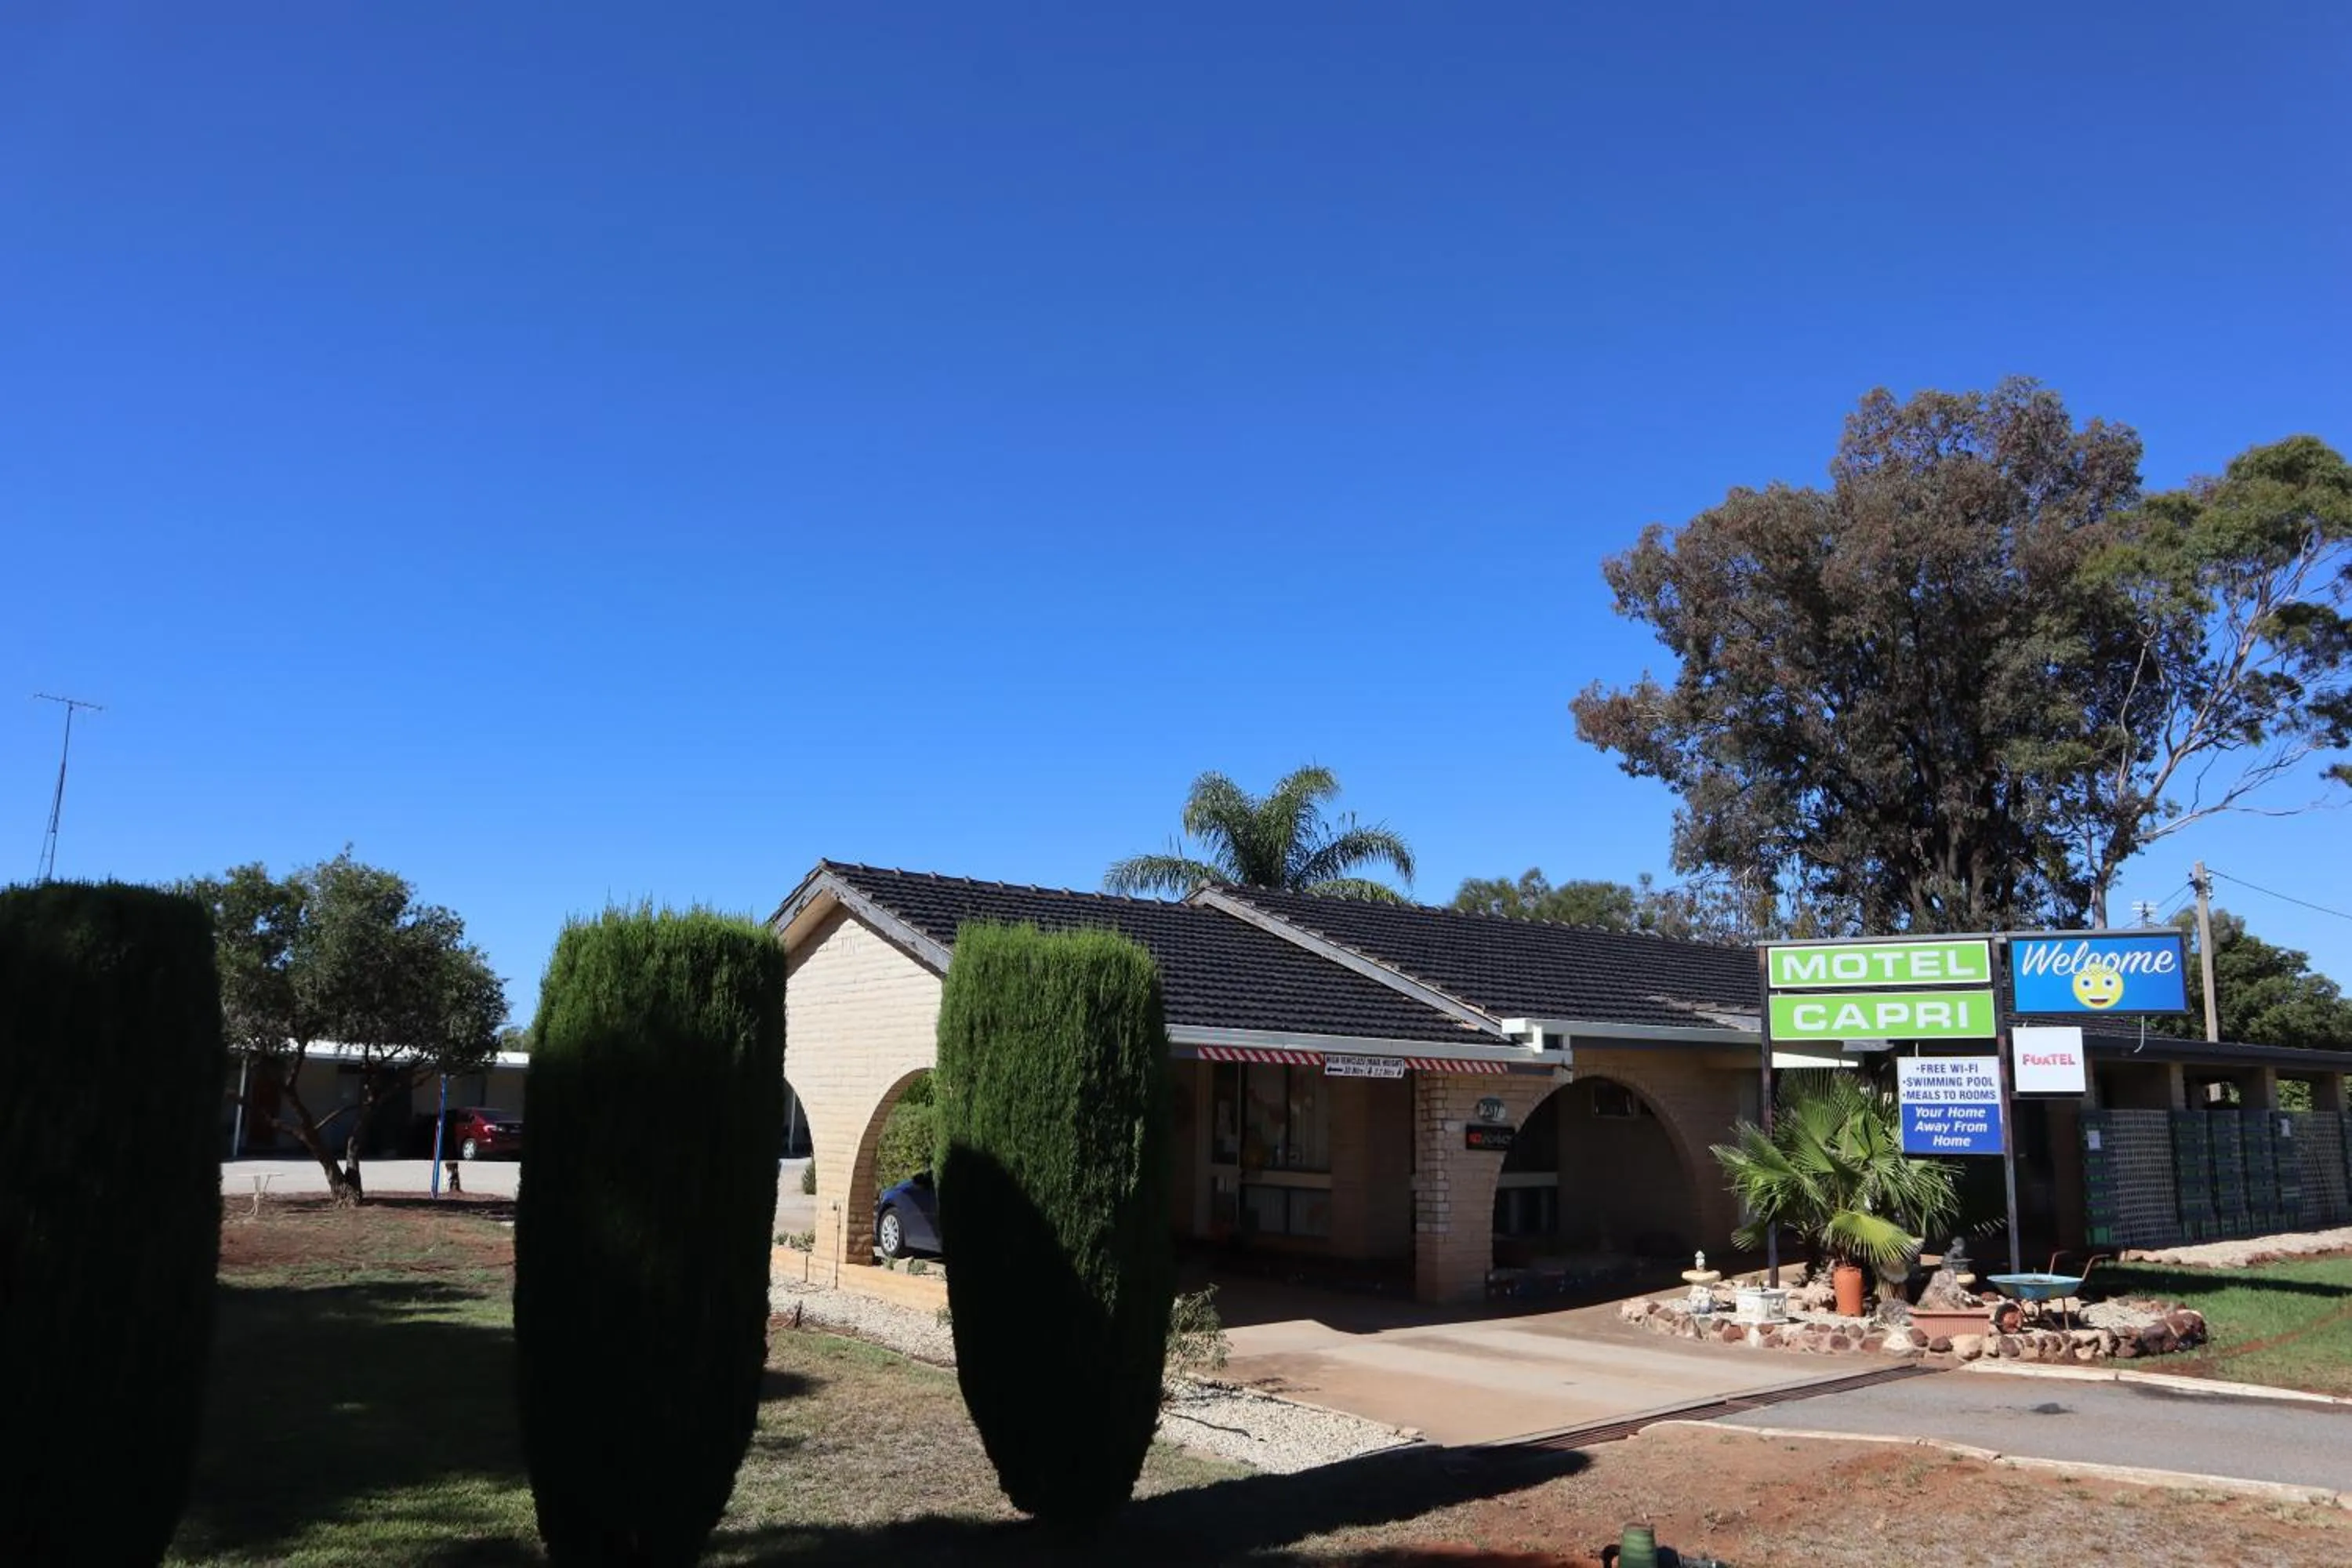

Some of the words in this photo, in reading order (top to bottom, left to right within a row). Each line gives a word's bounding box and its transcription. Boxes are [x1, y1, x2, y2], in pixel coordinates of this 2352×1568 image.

[2022, 941, 2176, 976] Welcome
[1783, 950, 1976, 980] MOTEL
[1793, 1001, 1969, 1031] CAPRI
[1951, 1064, 1978, 1073] WI-FI
[1907, 1077, 1962, 1087] SWIMMING
[1967, 1077, 1994, 1086] POOL
[1907, 1091, 1940, 1100] MEALS
[1960, 1091, 1996, 1099] ROOMS
[1915, 1106, 1944, 1117] Your
[1948, 1107, 1986, 1118] Home
[1915, 1121, 1950, 1134] Away
[1955, 1121, 1987, 1132] From
[1933, 1135, 1972, 1146] Home
